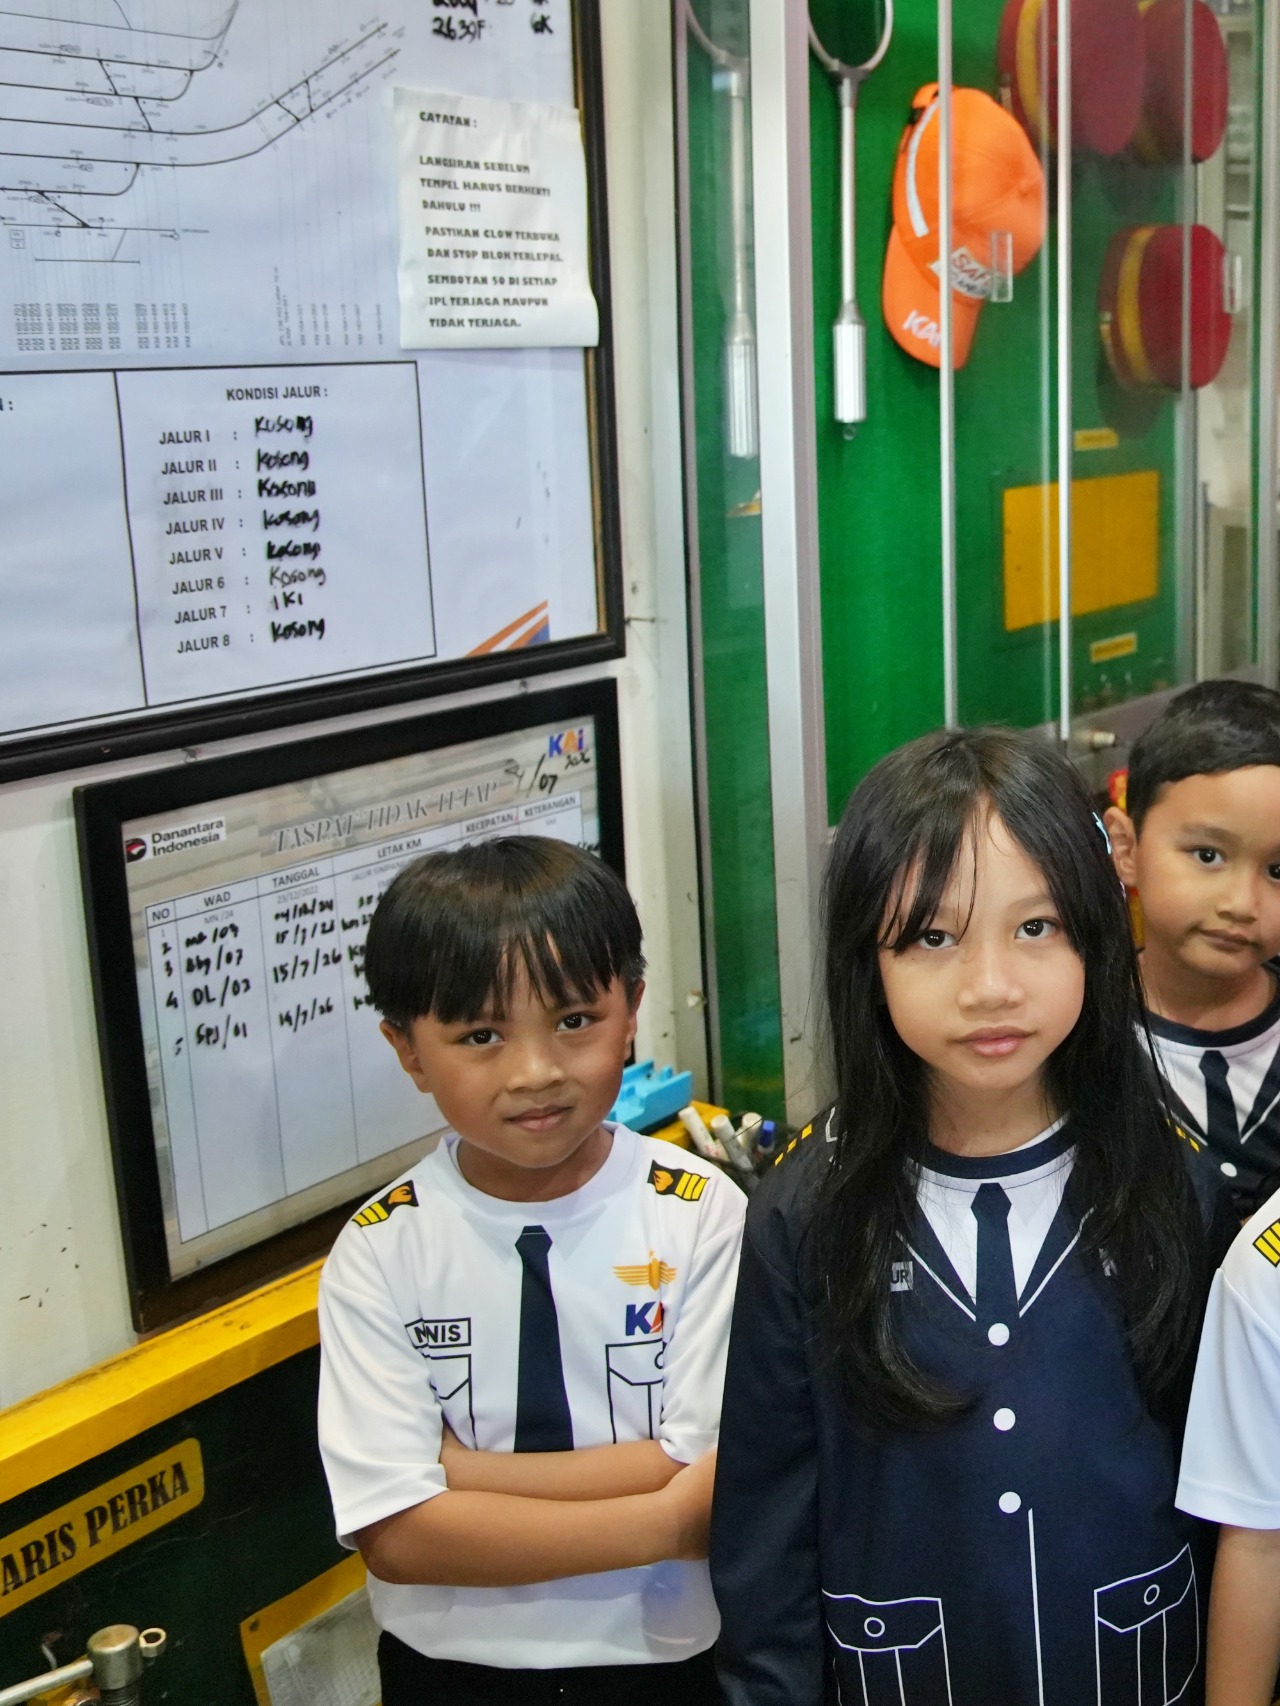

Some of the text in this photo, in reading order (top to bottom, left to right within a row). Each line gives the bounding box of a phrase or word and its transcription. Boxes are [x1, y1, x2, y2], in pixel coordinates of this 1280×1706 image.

[419, 111, 470, 127] CATATAN
[419, 156, 530, 173] LANGSIRAN SEBELUM
[420, 178, 551, 196] TEMPEL HARUS BERHENTI
[422, 200, 466, 212] DAHULU
[425, 226, 560, 242] PASTIKAN CLOW TERBUKA
[427, 248, 450, 258] DAN
[452, 249, 478, 259] STOP
[482, 251, 511, 260] BLOK
[427, 274, 488, 286] SEMBOYAN
[508, 277, 520, 286] DI
[522, 277, 558, 287] SETIAP
[451, 296, 500, 307] TERJAGA
[502, 297, 549, 307] MAUPUN
[429, 318, 465, 328] TIDAK
[226, 387, 278, 401] KONDISI
[282, 385, 321, 399] JALUR
[160, 431, 202, 444] JALUR
[206, 430, 210, 442] I
[162, 460, 204, 475] JALUR
[208, 459, 217, 472] II
[163, 490, 206, 505] JALUR
[210, 488, 223, 501] III
[166, 519, 208, 535] JALUR
[212, 517, 225, 531] IV
[169, 548, 211, 565] JALUR
[215, 547, 223, 559] V
[172, 578, 213, 595] JALUR
[217, 576, 225, 589] 6
[175, 607, 216, 624] JALUR
[219, 605, 227, 618] 7
[178, 636, 218, 654] JALUR
[222, 634, 231, 647] 8
[152, 820, 224, 844] Danantara
[152, 832, 220, 856] Indonesia
[152, 796, 577, 921] NO WAD TANGGAL LETAK KM KECEPATAN KETERANGAN
[166, 991, 178, 1008] 4
[1, 1461, 190, 1596] ARIS PERKA
